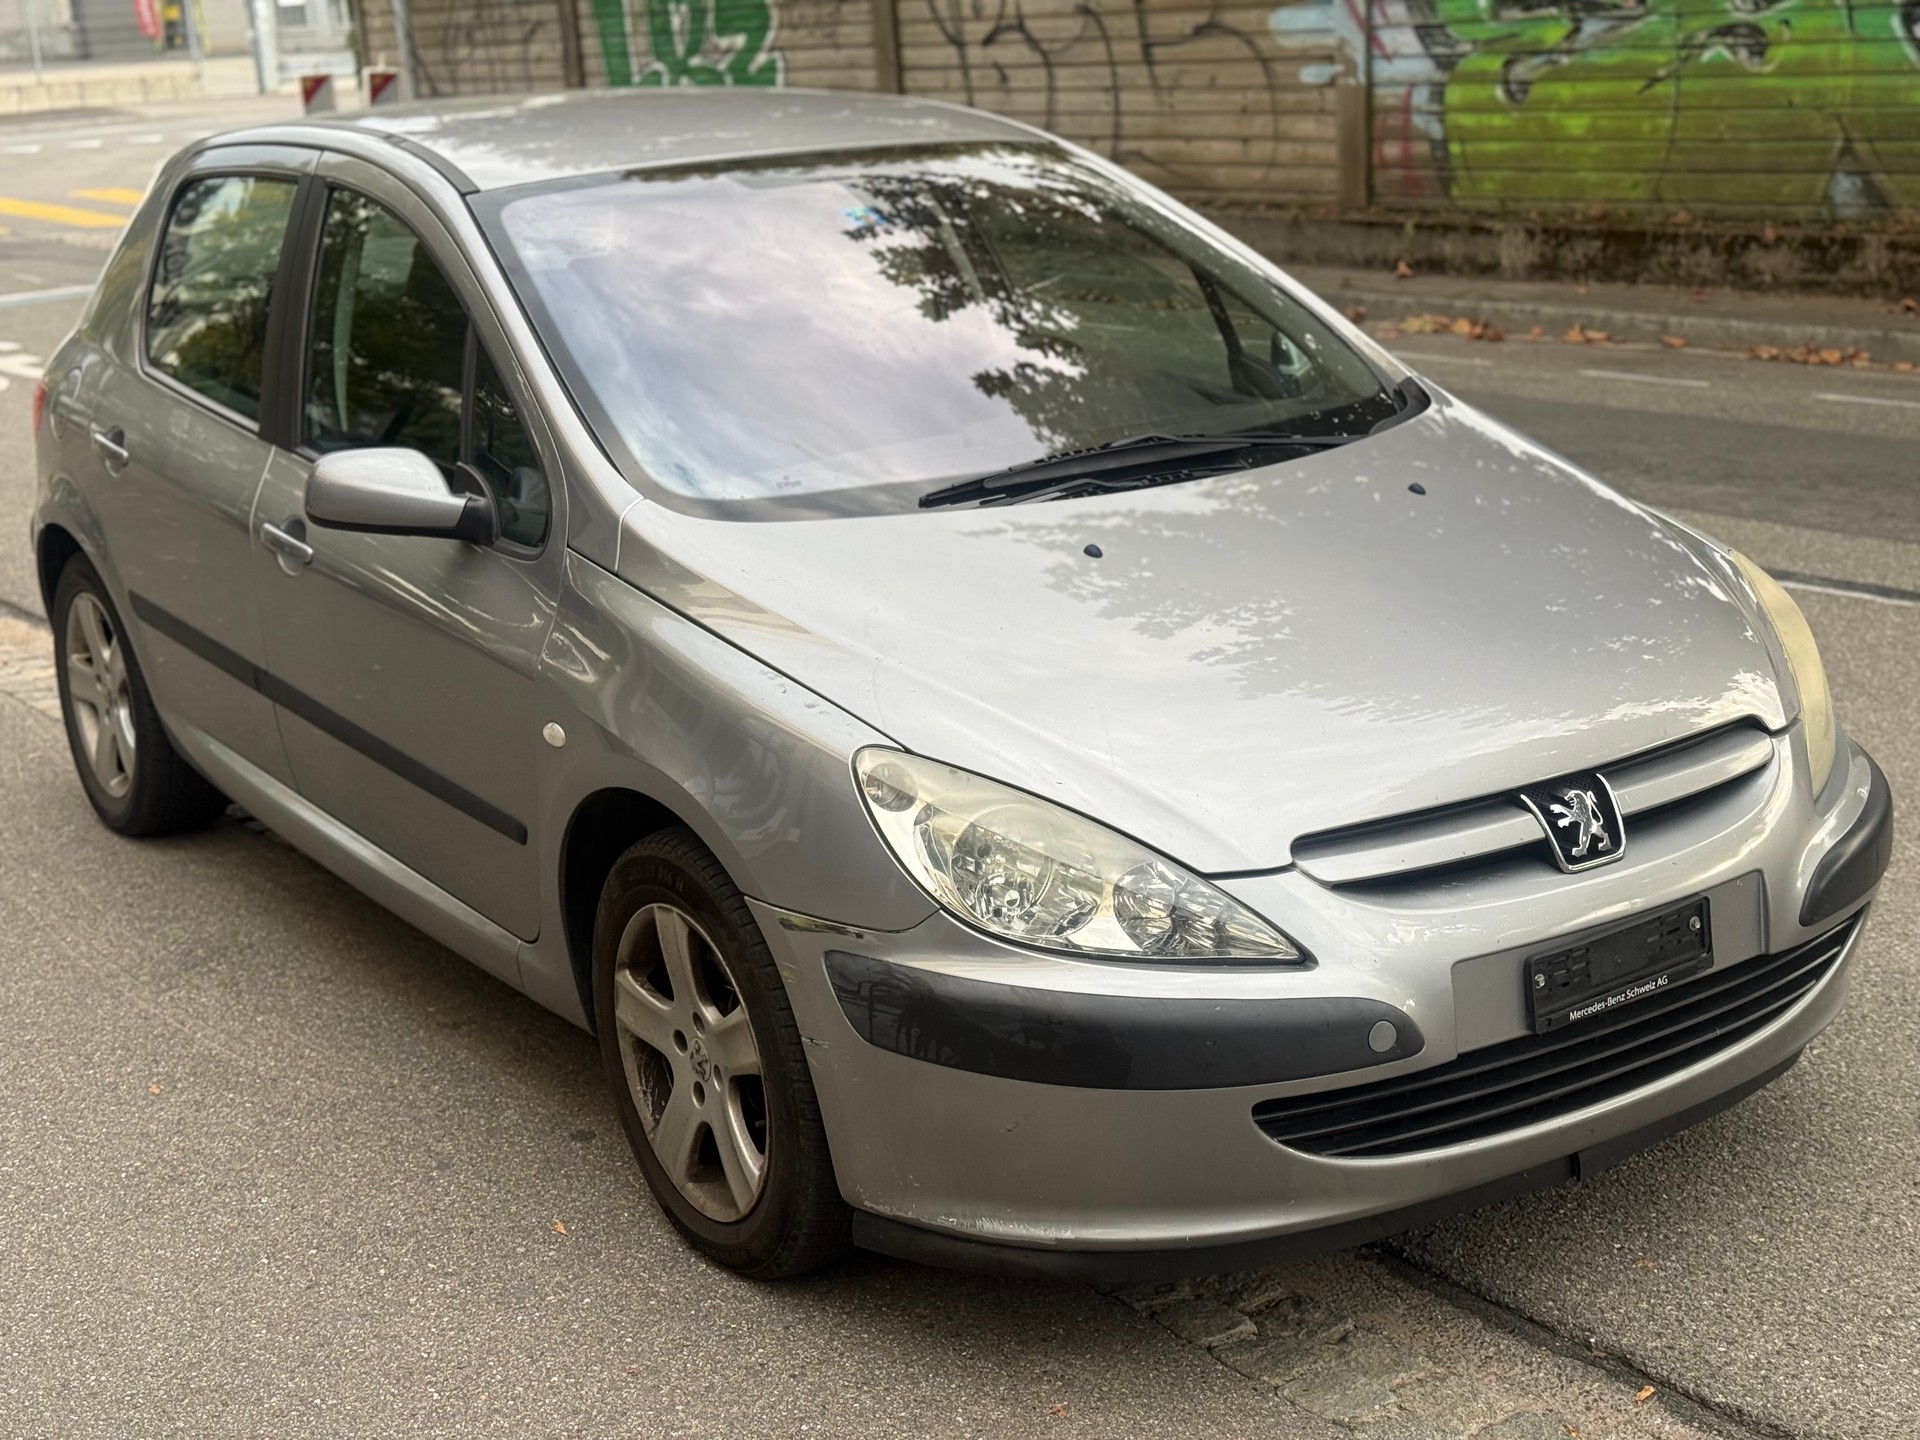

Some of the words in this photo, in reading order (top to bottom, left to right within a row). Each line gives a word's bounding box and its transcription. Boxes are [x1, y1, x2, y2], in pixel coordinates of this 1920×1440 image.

[1569, 993, 1625, 1021] Mercedes-Benz
[1626, 981, 1656, 999] Schweiz
[1657, 975, 1668, 987] AG
